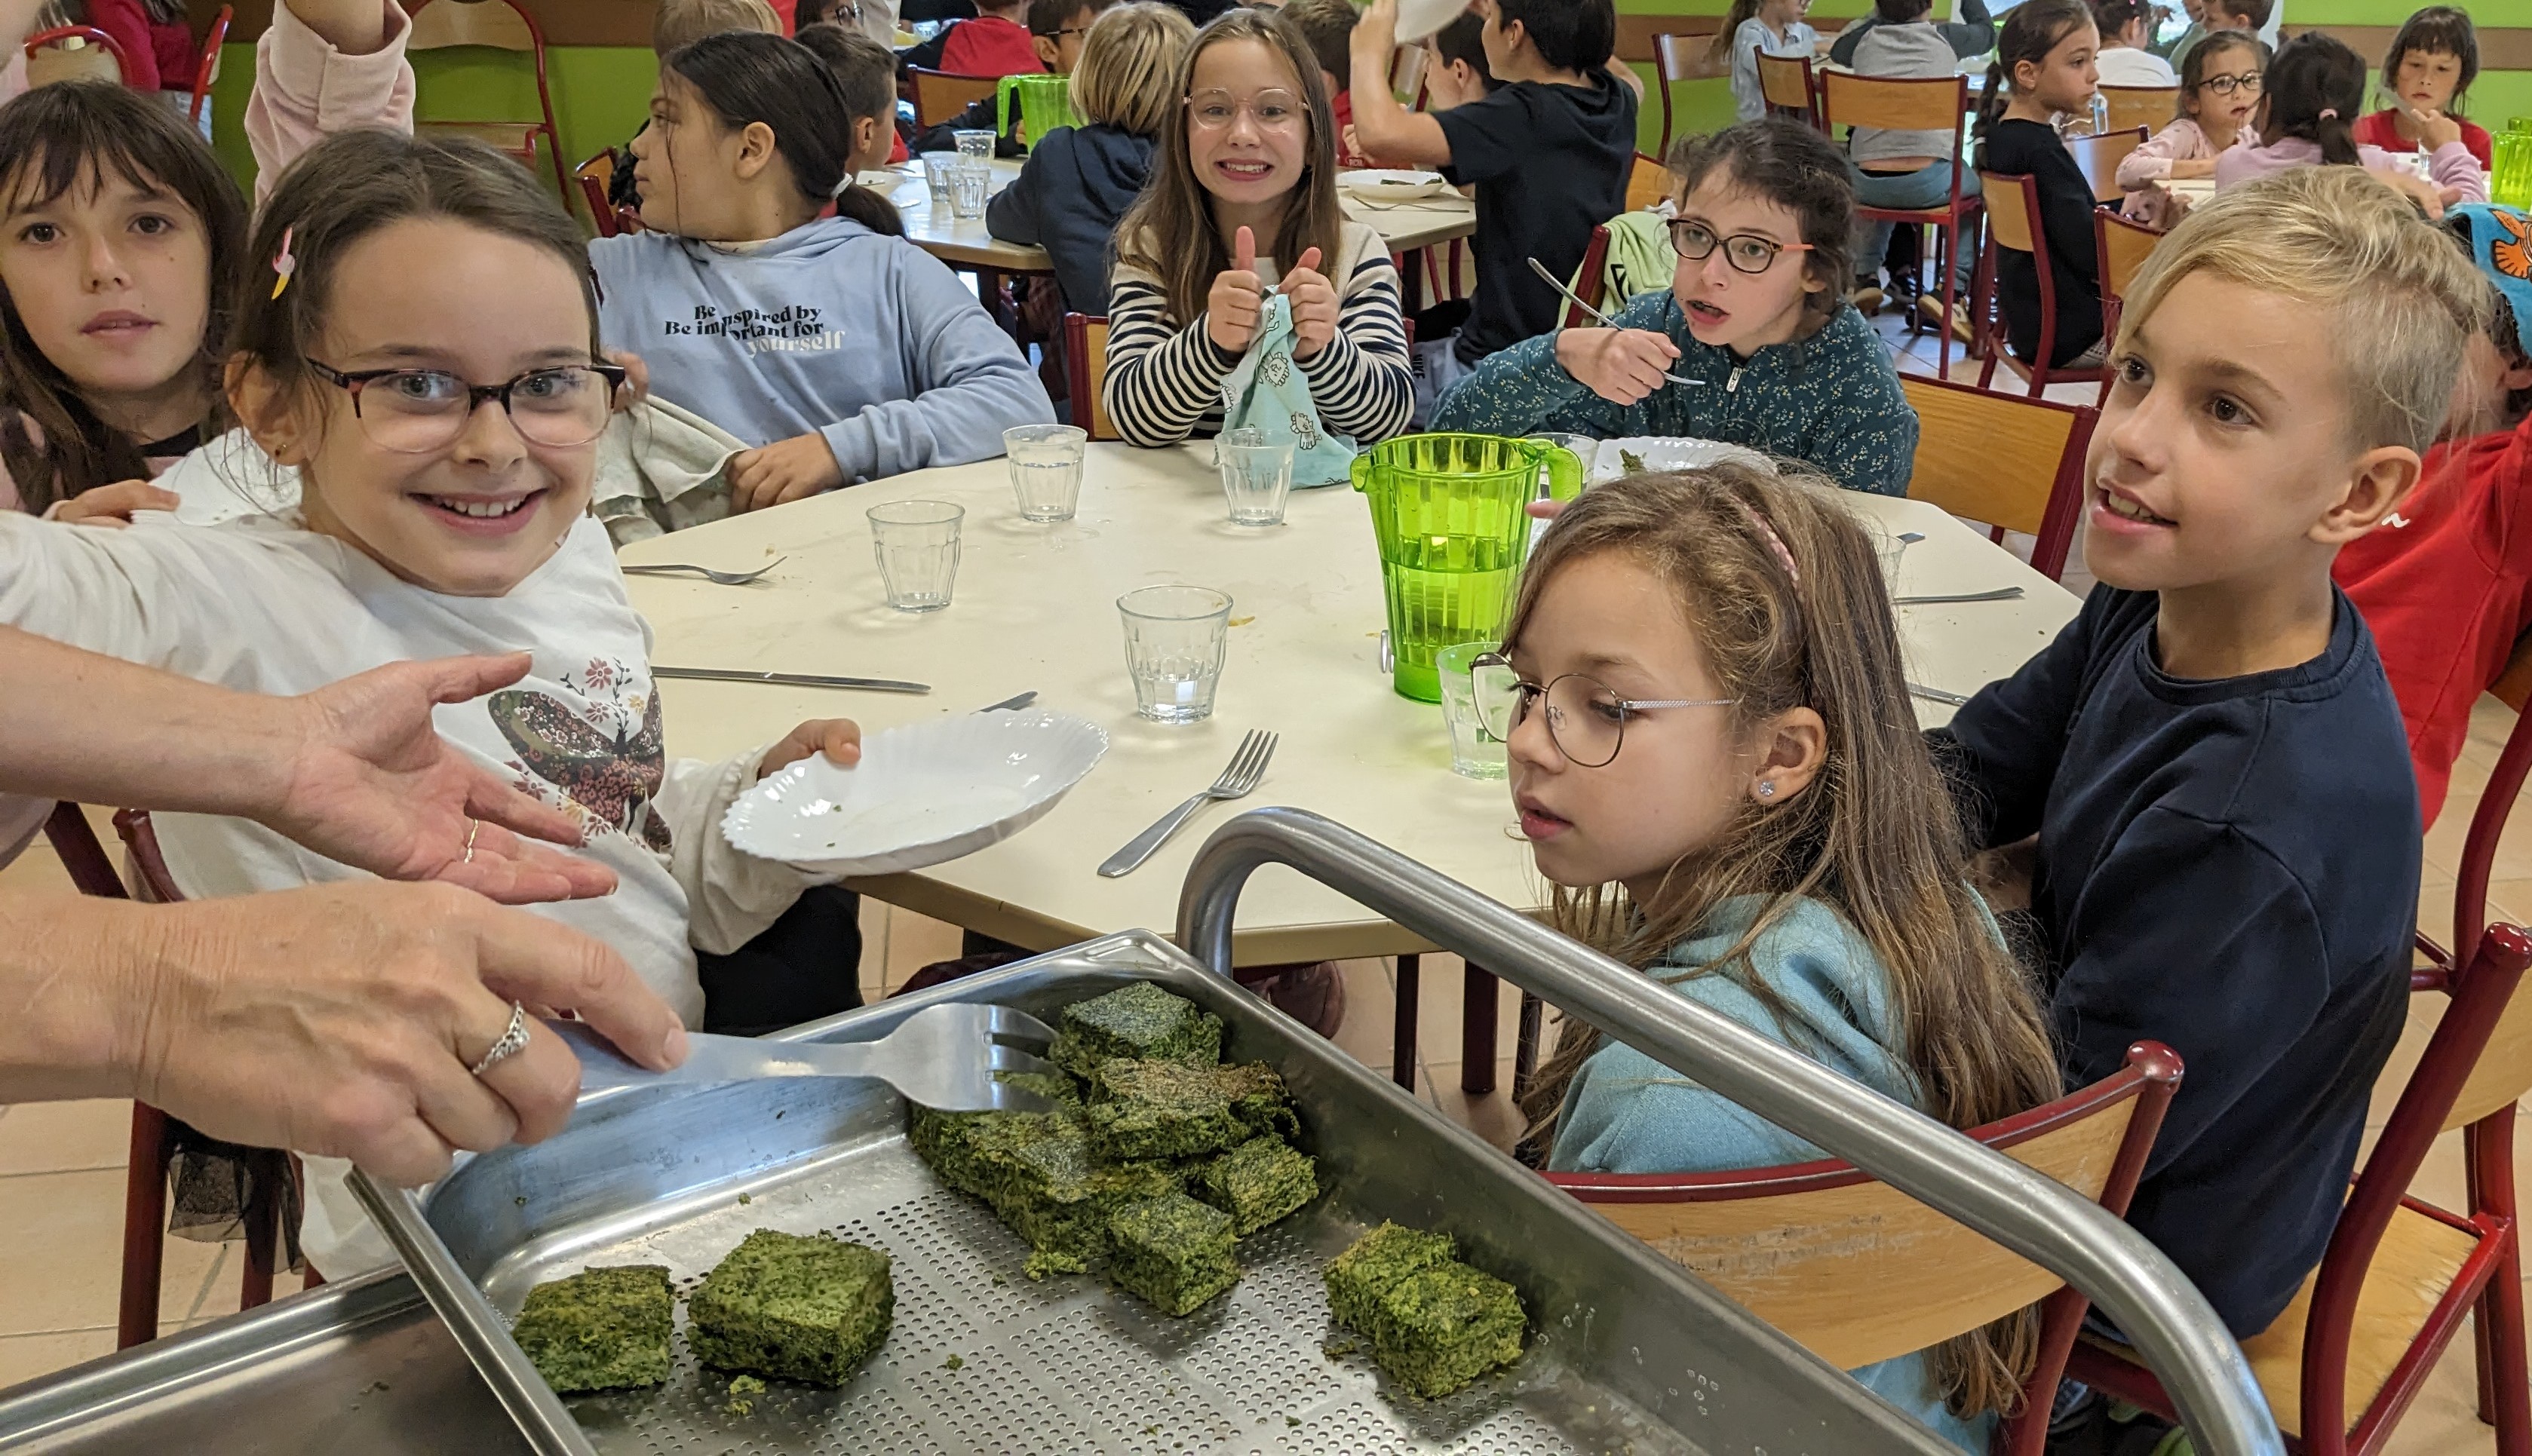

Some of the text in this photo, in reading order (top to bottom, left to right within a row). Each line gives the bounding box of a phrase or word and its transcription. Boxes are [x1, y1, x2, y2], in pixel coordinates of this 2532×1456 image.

[695, 305, 821, 327] Be nspired by
[664, 320, 691, 336] Be
[793, 320, 824, 337] for
[747, 330, 845, 358] yourself
